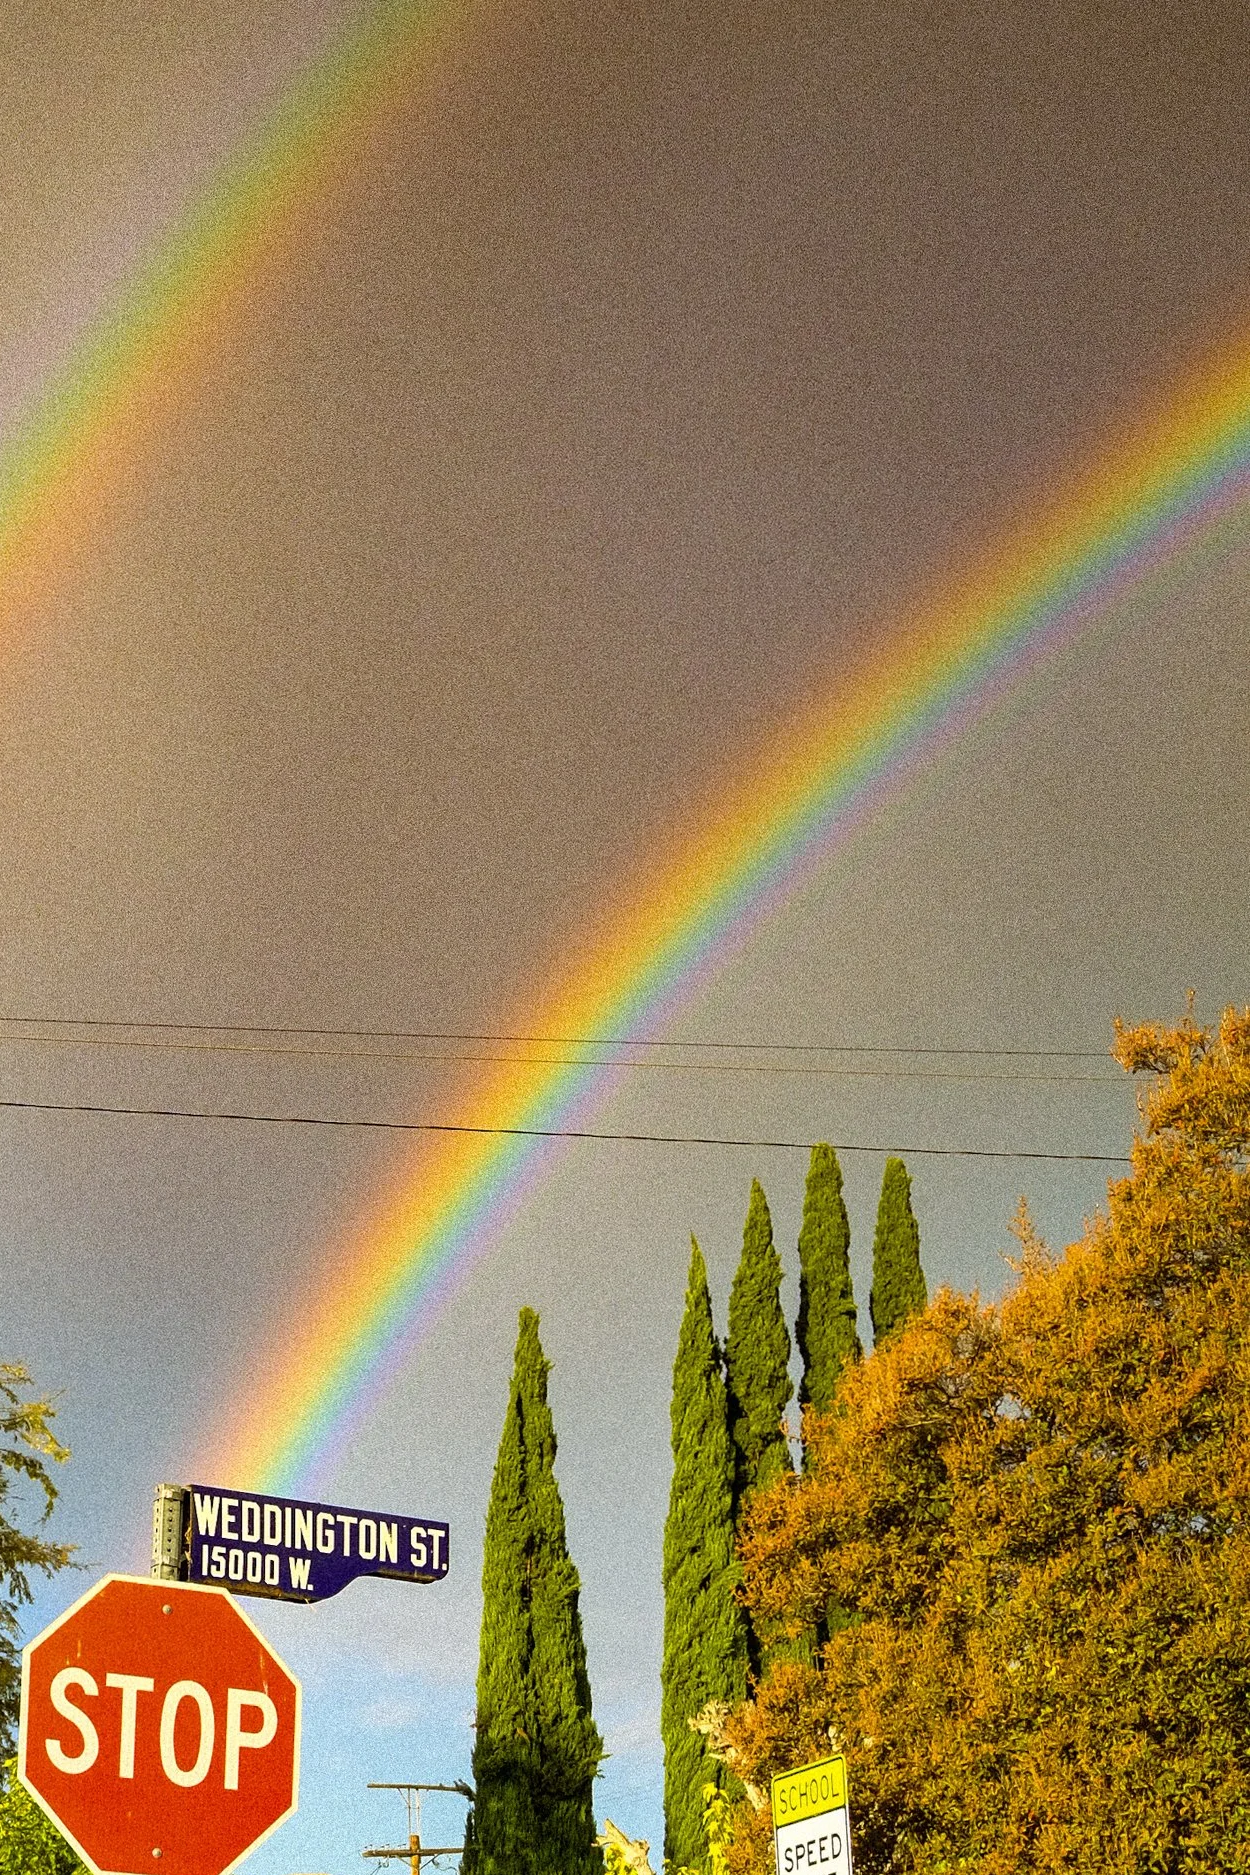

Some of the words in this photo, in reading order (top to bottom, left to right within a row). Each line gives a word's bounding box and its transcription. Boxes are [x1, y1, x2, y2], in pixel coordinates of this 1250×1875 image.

[193, 1493, 398, 1564] WEDDINGTON
[410, 1526, 447, 1571] ST.
[201, 1544, 280, 1586] 15000
[289, 1556, 314, 1591] W.
[45, 1667, 278, 1791] STOP
[779, 1773, 840, 1815] SCHOOL
[784, 1832, 842, 1874] SPEED
